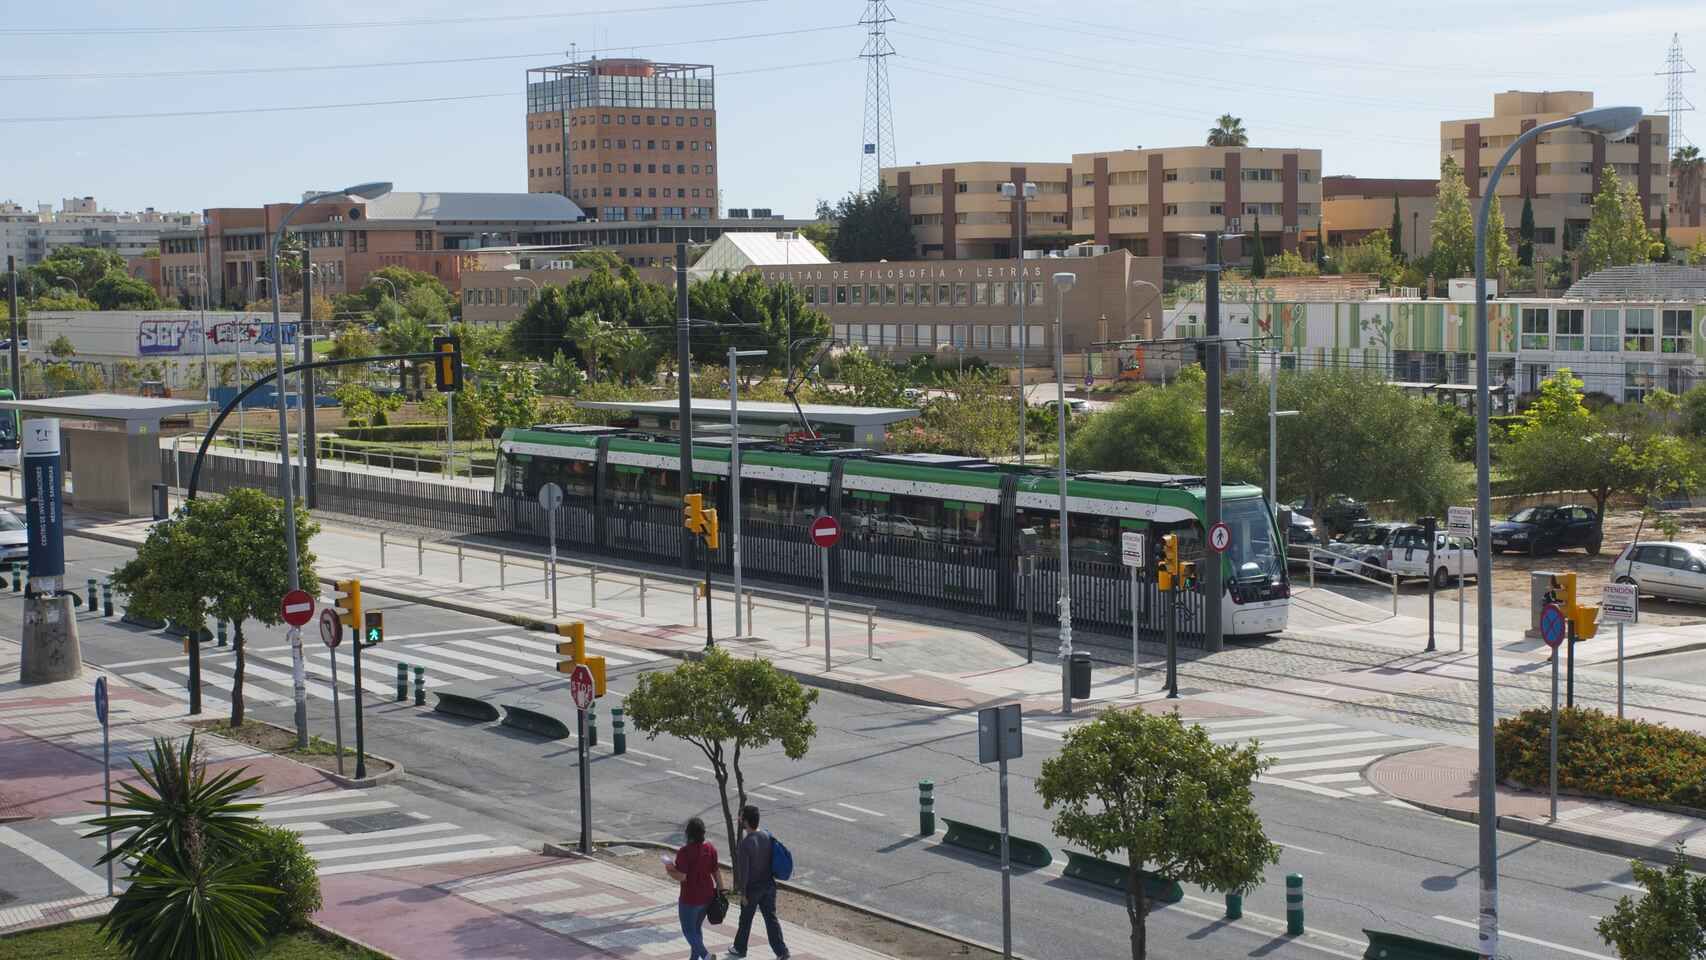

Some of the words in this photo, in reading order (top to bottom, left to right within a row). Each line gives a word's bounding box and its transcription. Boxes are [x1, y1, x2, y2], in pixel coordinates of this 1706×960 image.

[759, 271, 824, 281] ACULTAD
[833, 270, 849, 279] DE
[957, 268, 964, 278] Y
[976, 267, 1041, 277] LETRAS
[571, 681, 592, 695] STOP
